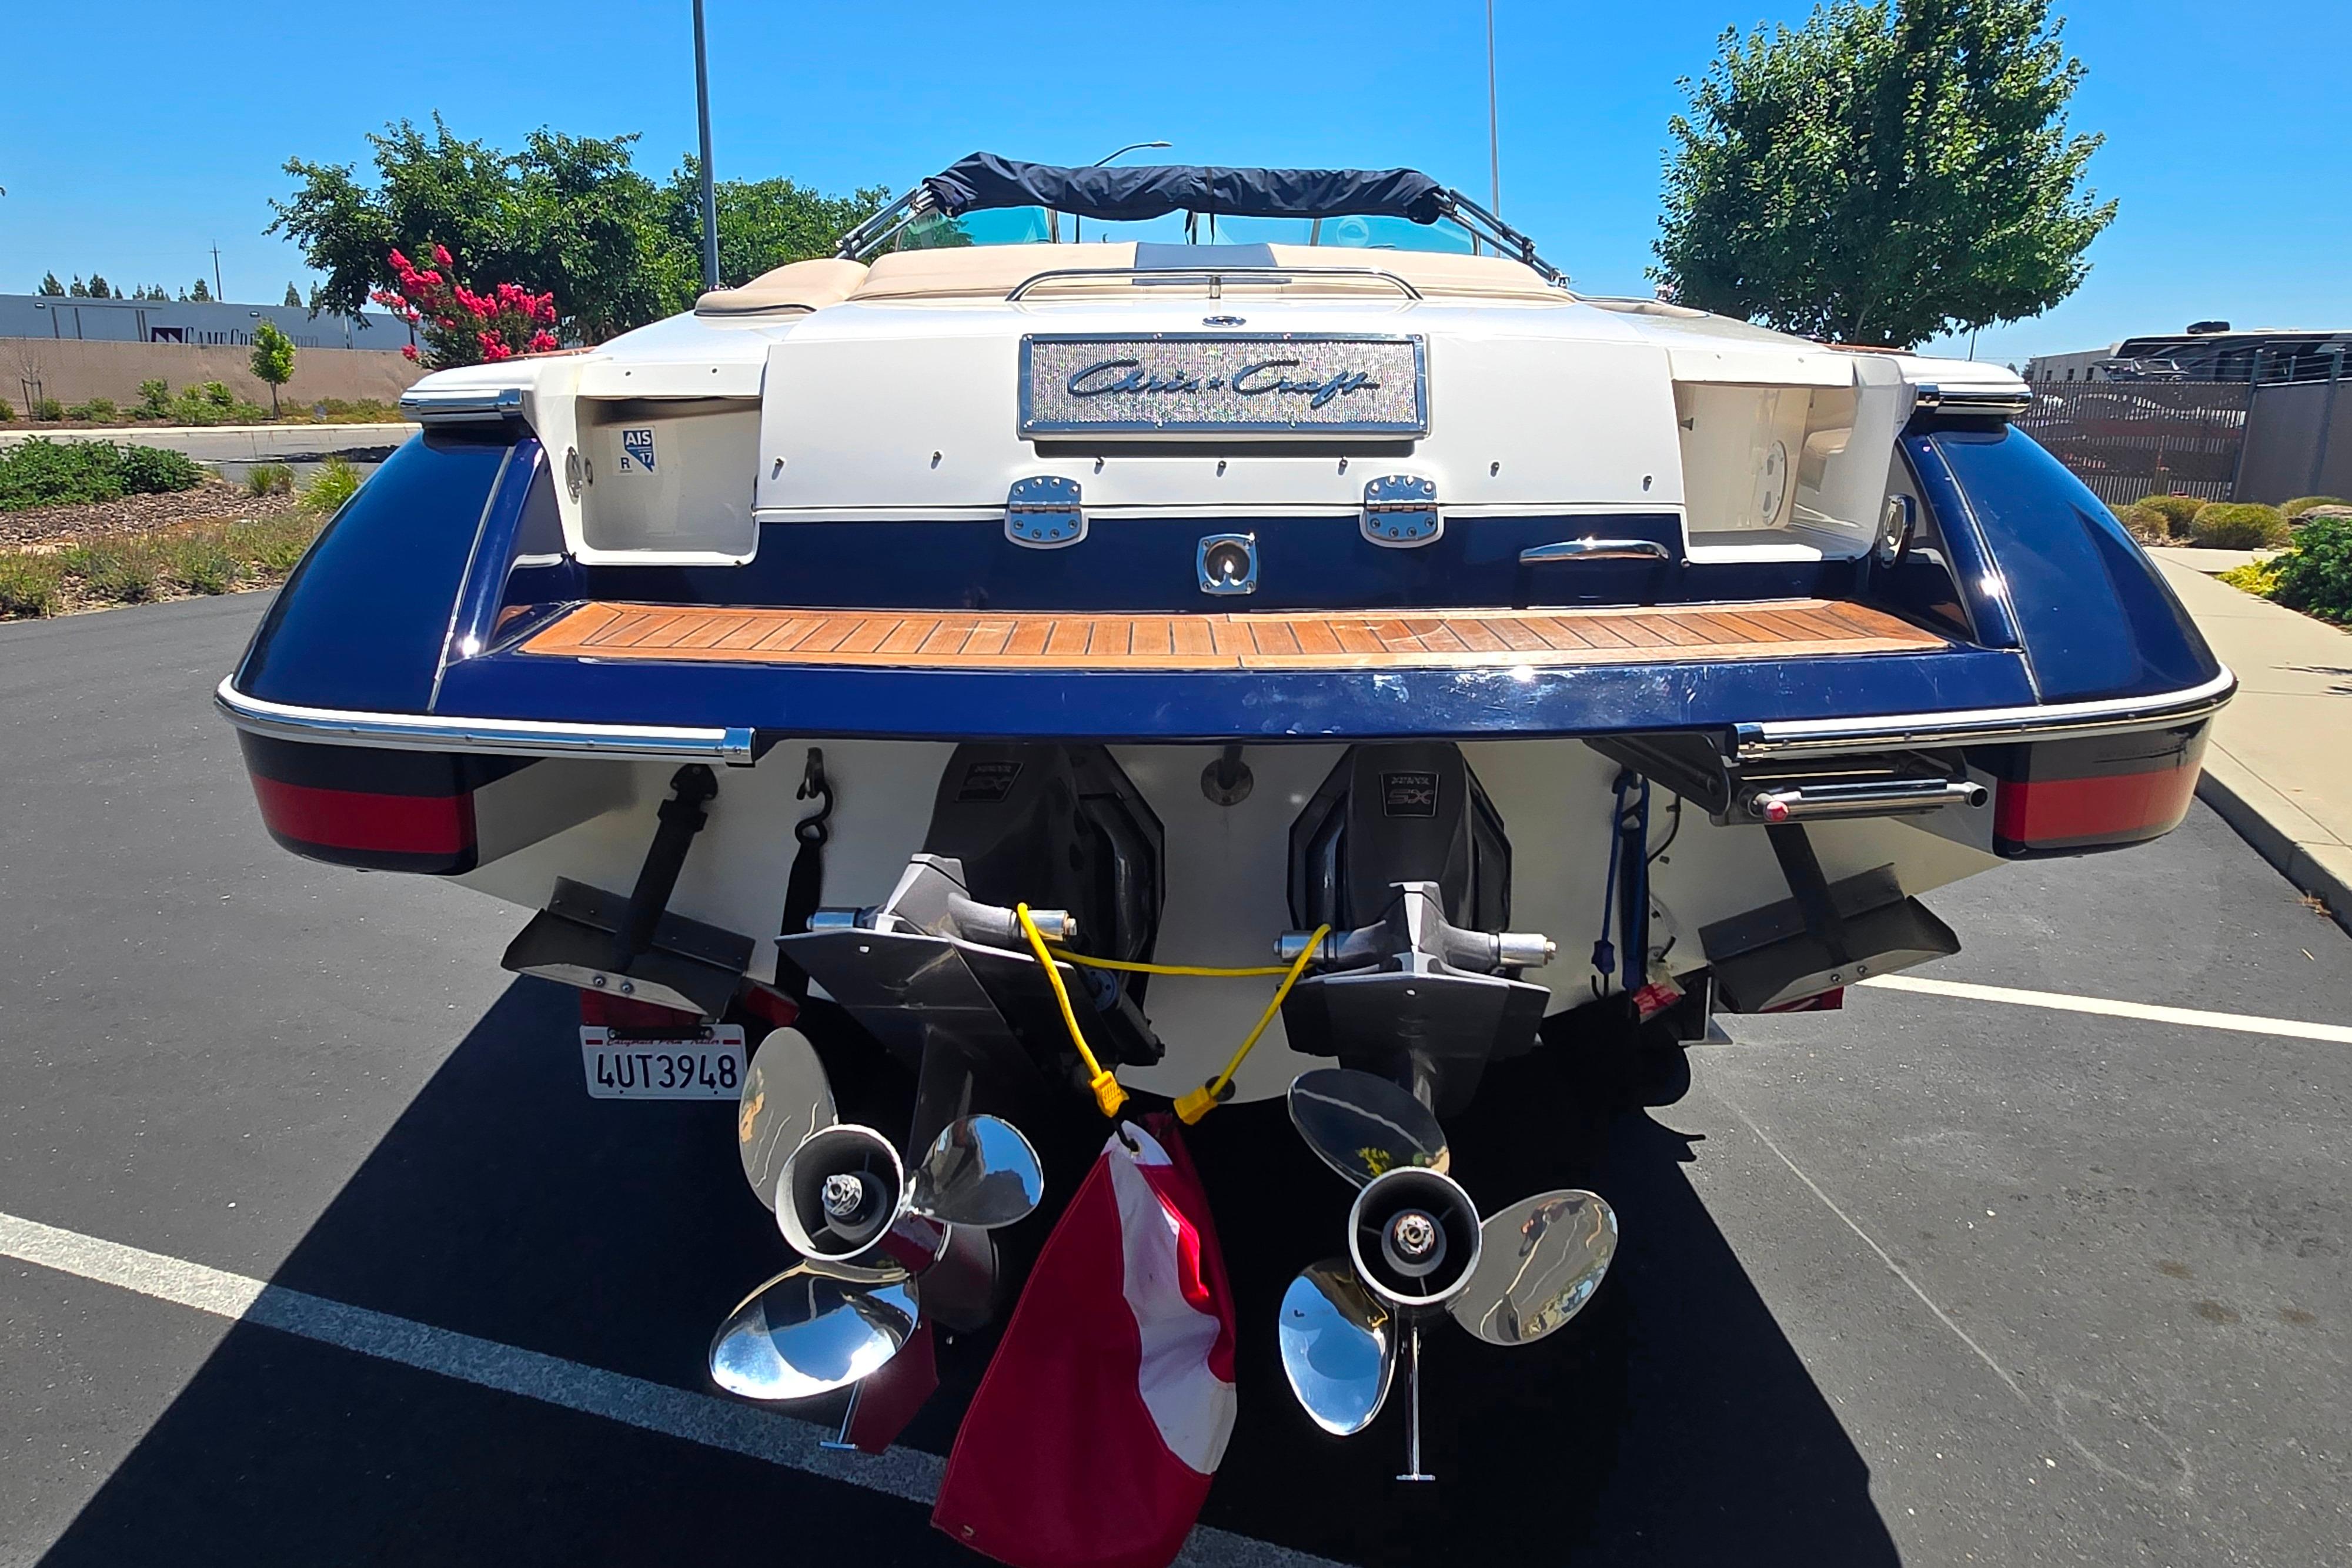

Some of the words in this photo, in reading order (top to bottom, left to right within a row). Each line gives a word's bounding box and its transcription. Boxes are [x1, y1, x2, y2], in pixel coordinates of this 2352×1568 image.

[1234, 359, 1381, 409] Craft
[625, 432, 651, 445] AIS
[620, 457, 631, 469] R
[639, 453, 652, 463] 17
[1388, 789, 1434, 804] SX
[597, 1054, 737, 1088] 4UT3948
